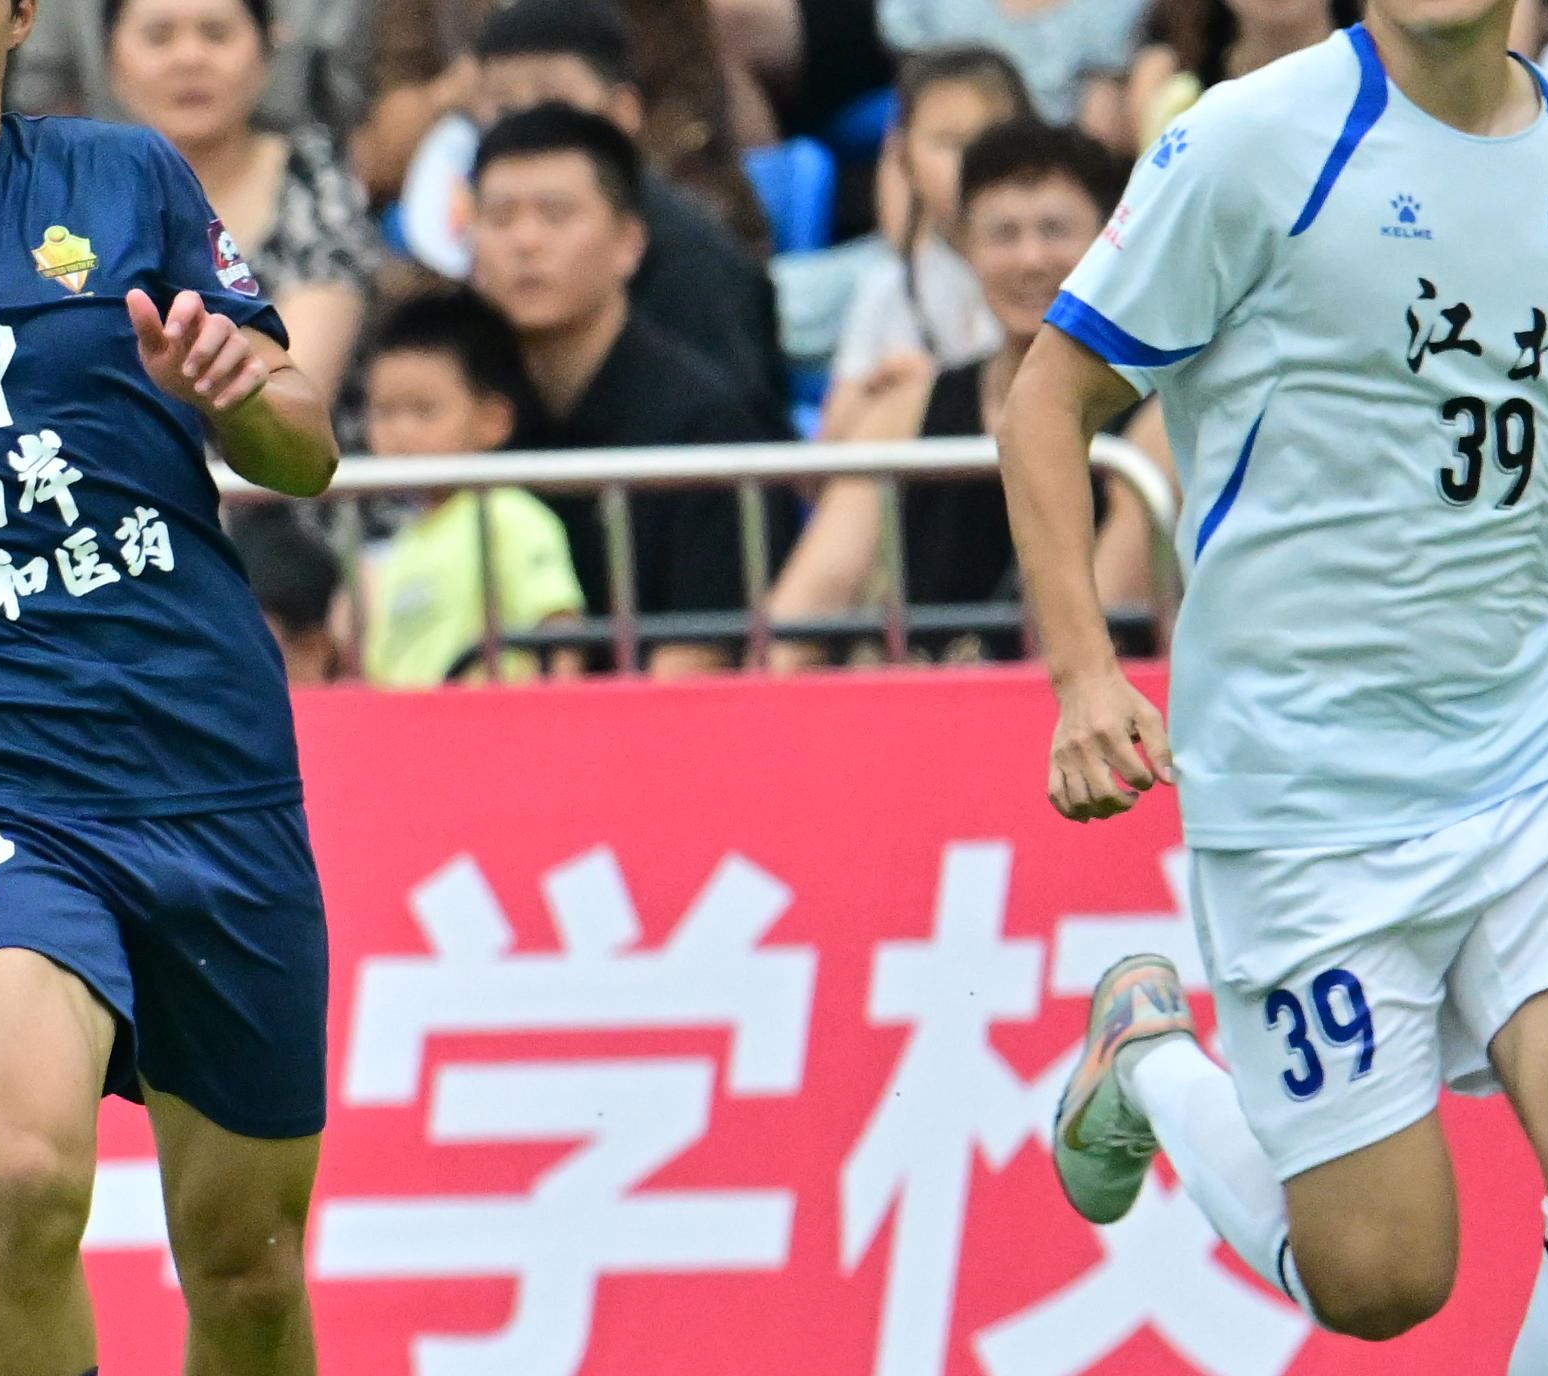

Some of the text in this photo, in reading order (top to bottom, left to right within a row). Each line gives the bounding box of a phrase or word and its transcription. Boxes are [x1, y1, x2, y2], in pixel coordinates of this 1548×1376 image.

[1380, 226, 1433, 240] KELME
[1435, 396, 1536, 509] 39
[1264, 968, 1376, 1102] 39
